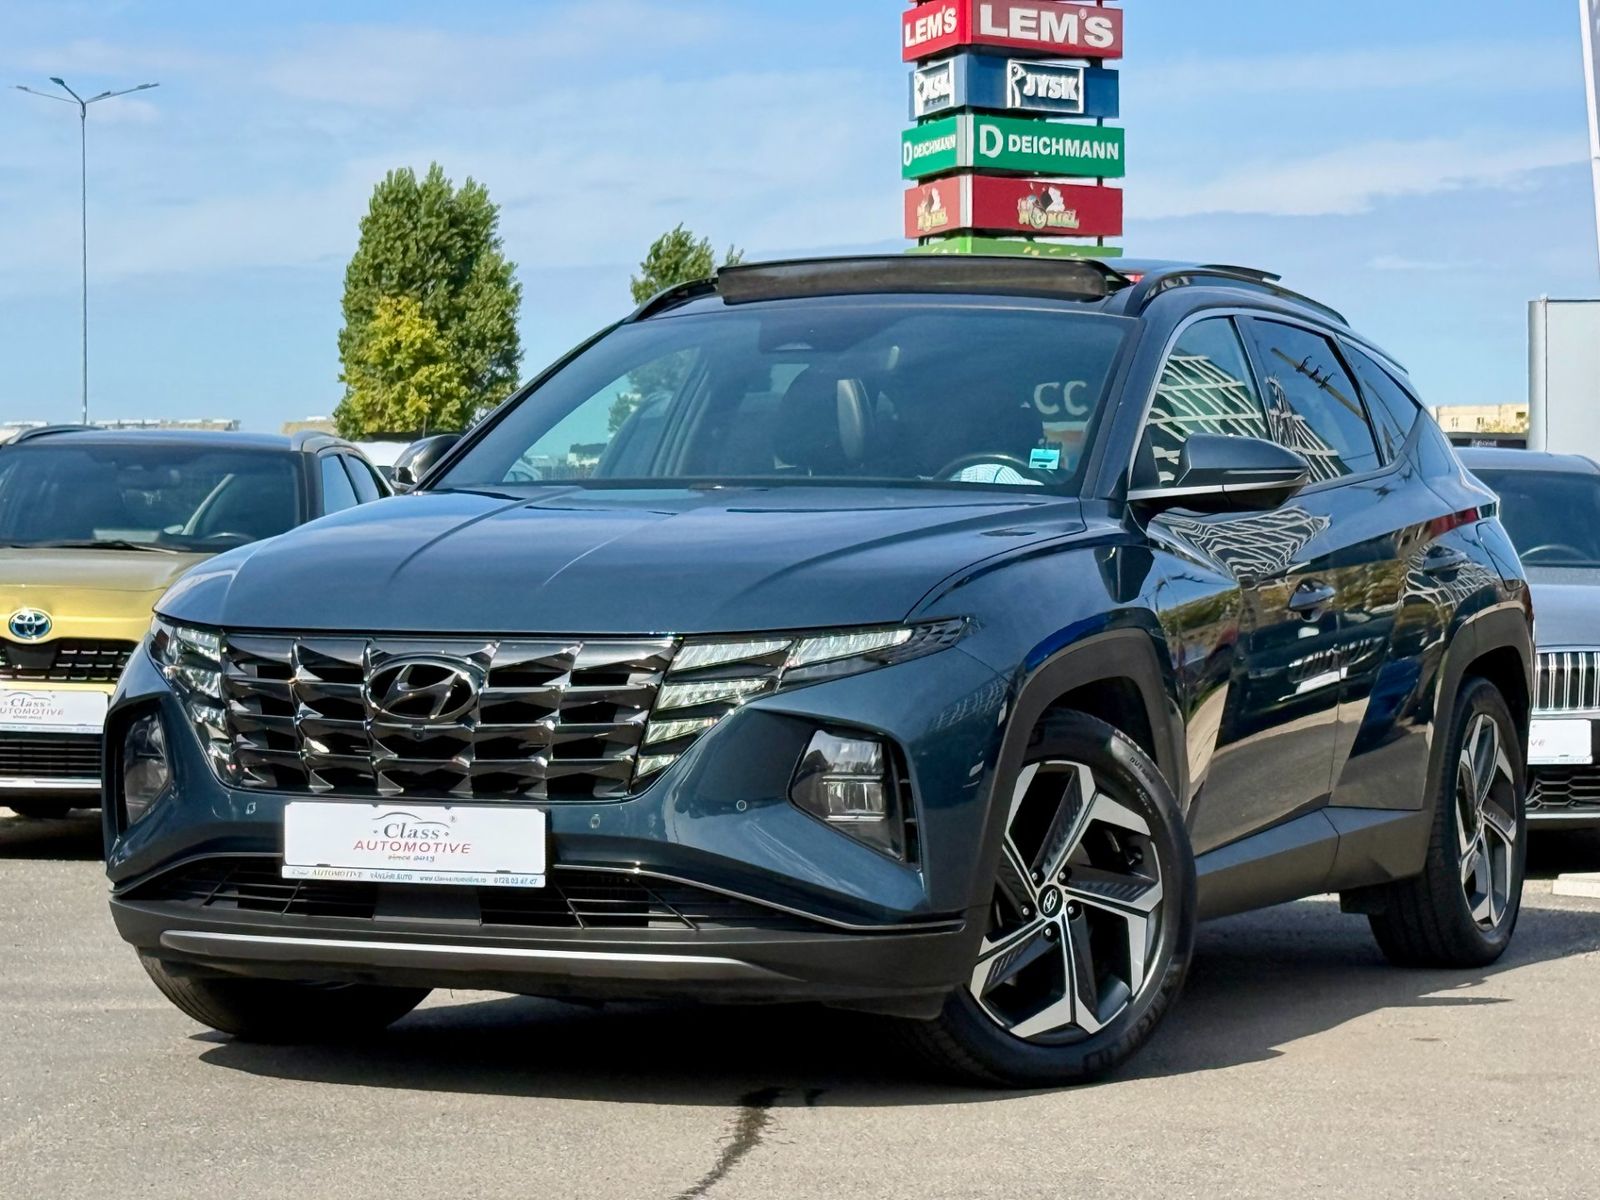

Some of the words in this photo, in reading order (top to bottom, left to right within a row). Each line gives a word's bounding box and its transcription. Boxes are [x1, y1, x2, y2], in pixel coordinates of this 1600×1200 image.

[905, 5, 957, 48] LEM'S
[980, 4, 1114, 48] LEM'S
[1024, 73, 1078, 101] JYSK
[913, 133, 956, 159] DEICHMANN
[1008, 134, 1119, 160] DEICHMANN
[0, 706, 64, 716] UTOMOTIVE
[10, 697, 46, 707] Class
[383, 822, 441, 840] Class
[353, 840, 473, 855] AUTOMOTIVE
